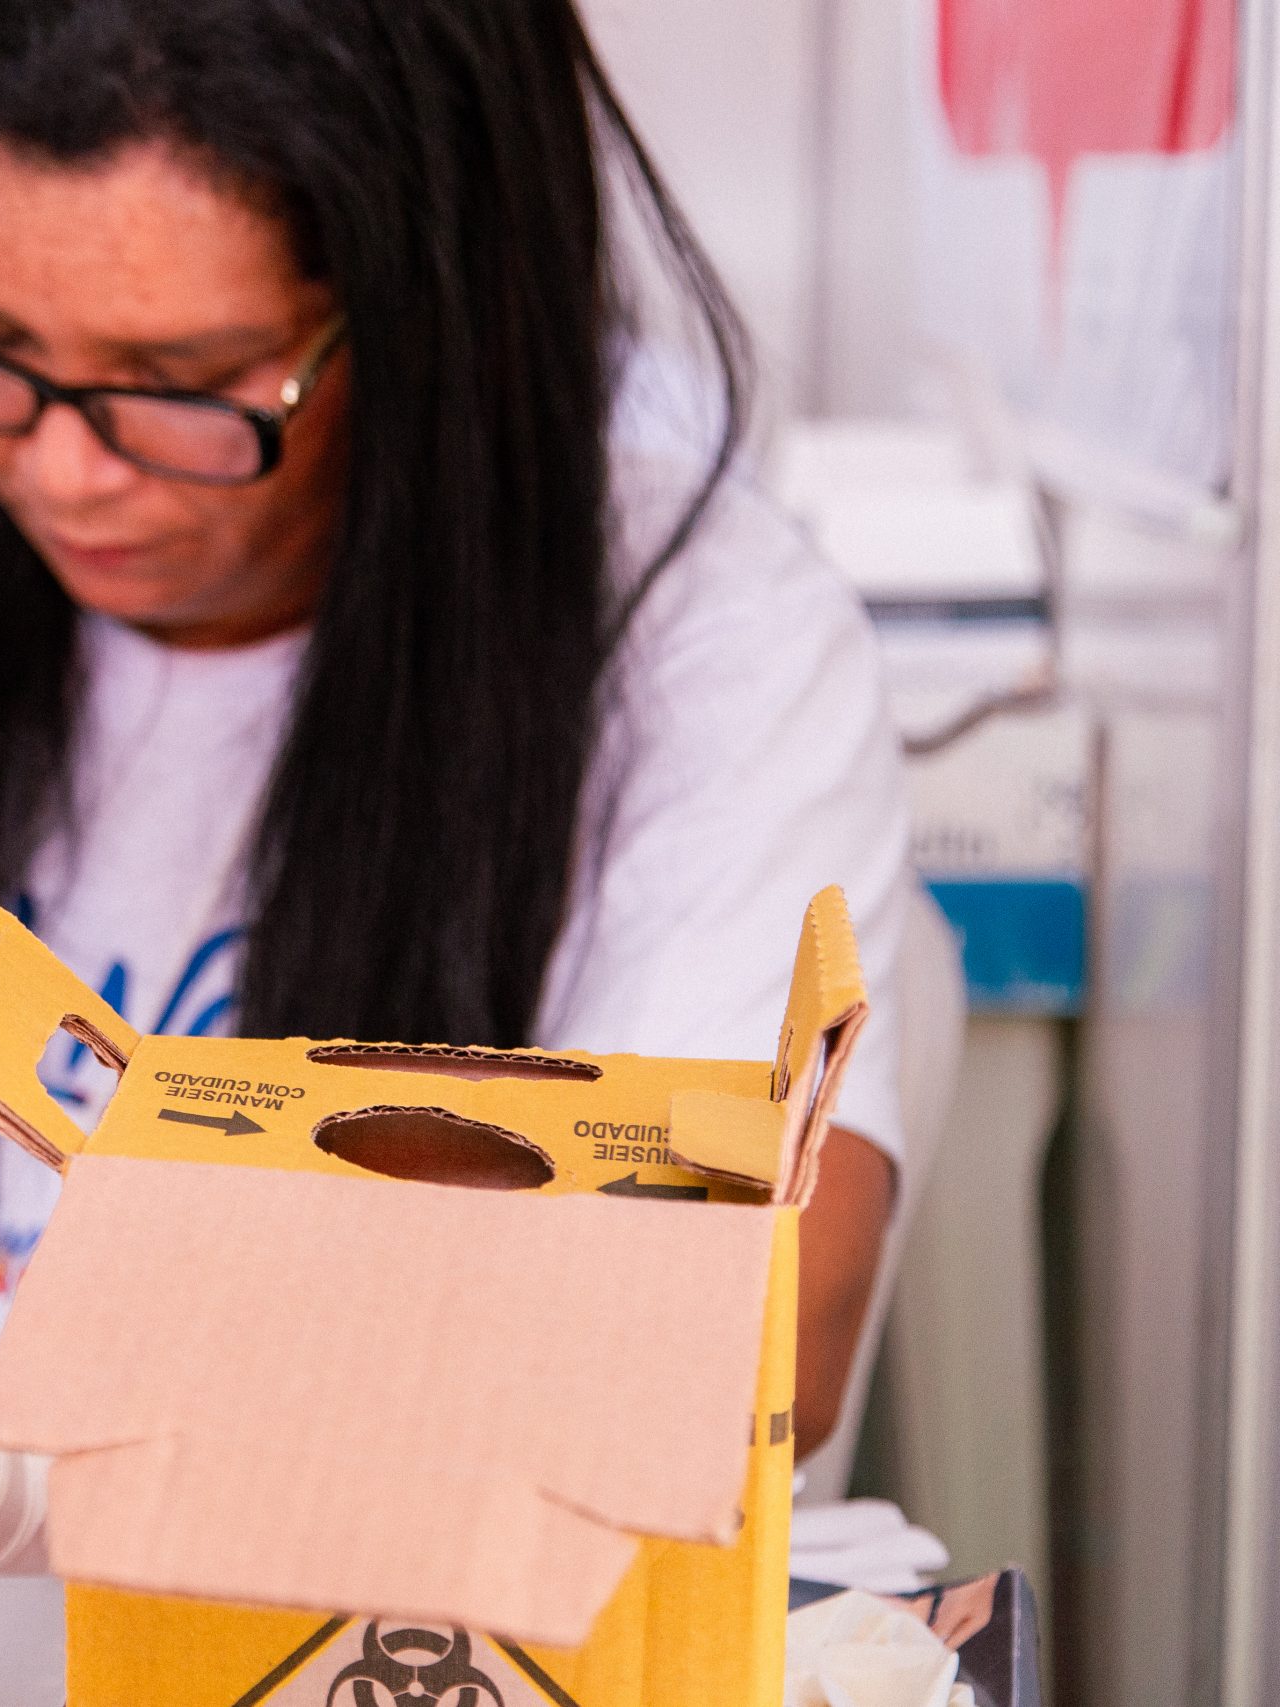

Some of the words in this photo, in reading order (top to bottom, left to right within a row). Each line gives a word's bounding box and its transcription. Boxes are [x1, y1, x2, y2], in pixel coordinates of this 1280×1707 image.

[154, 1071, 251, 1092] CUIDADO
[256, 1082, 306, 1099] COM
[165, 1086, 284, 1111] MANUSEIE
[592, 1143, 677, 1165] NUSEIE
